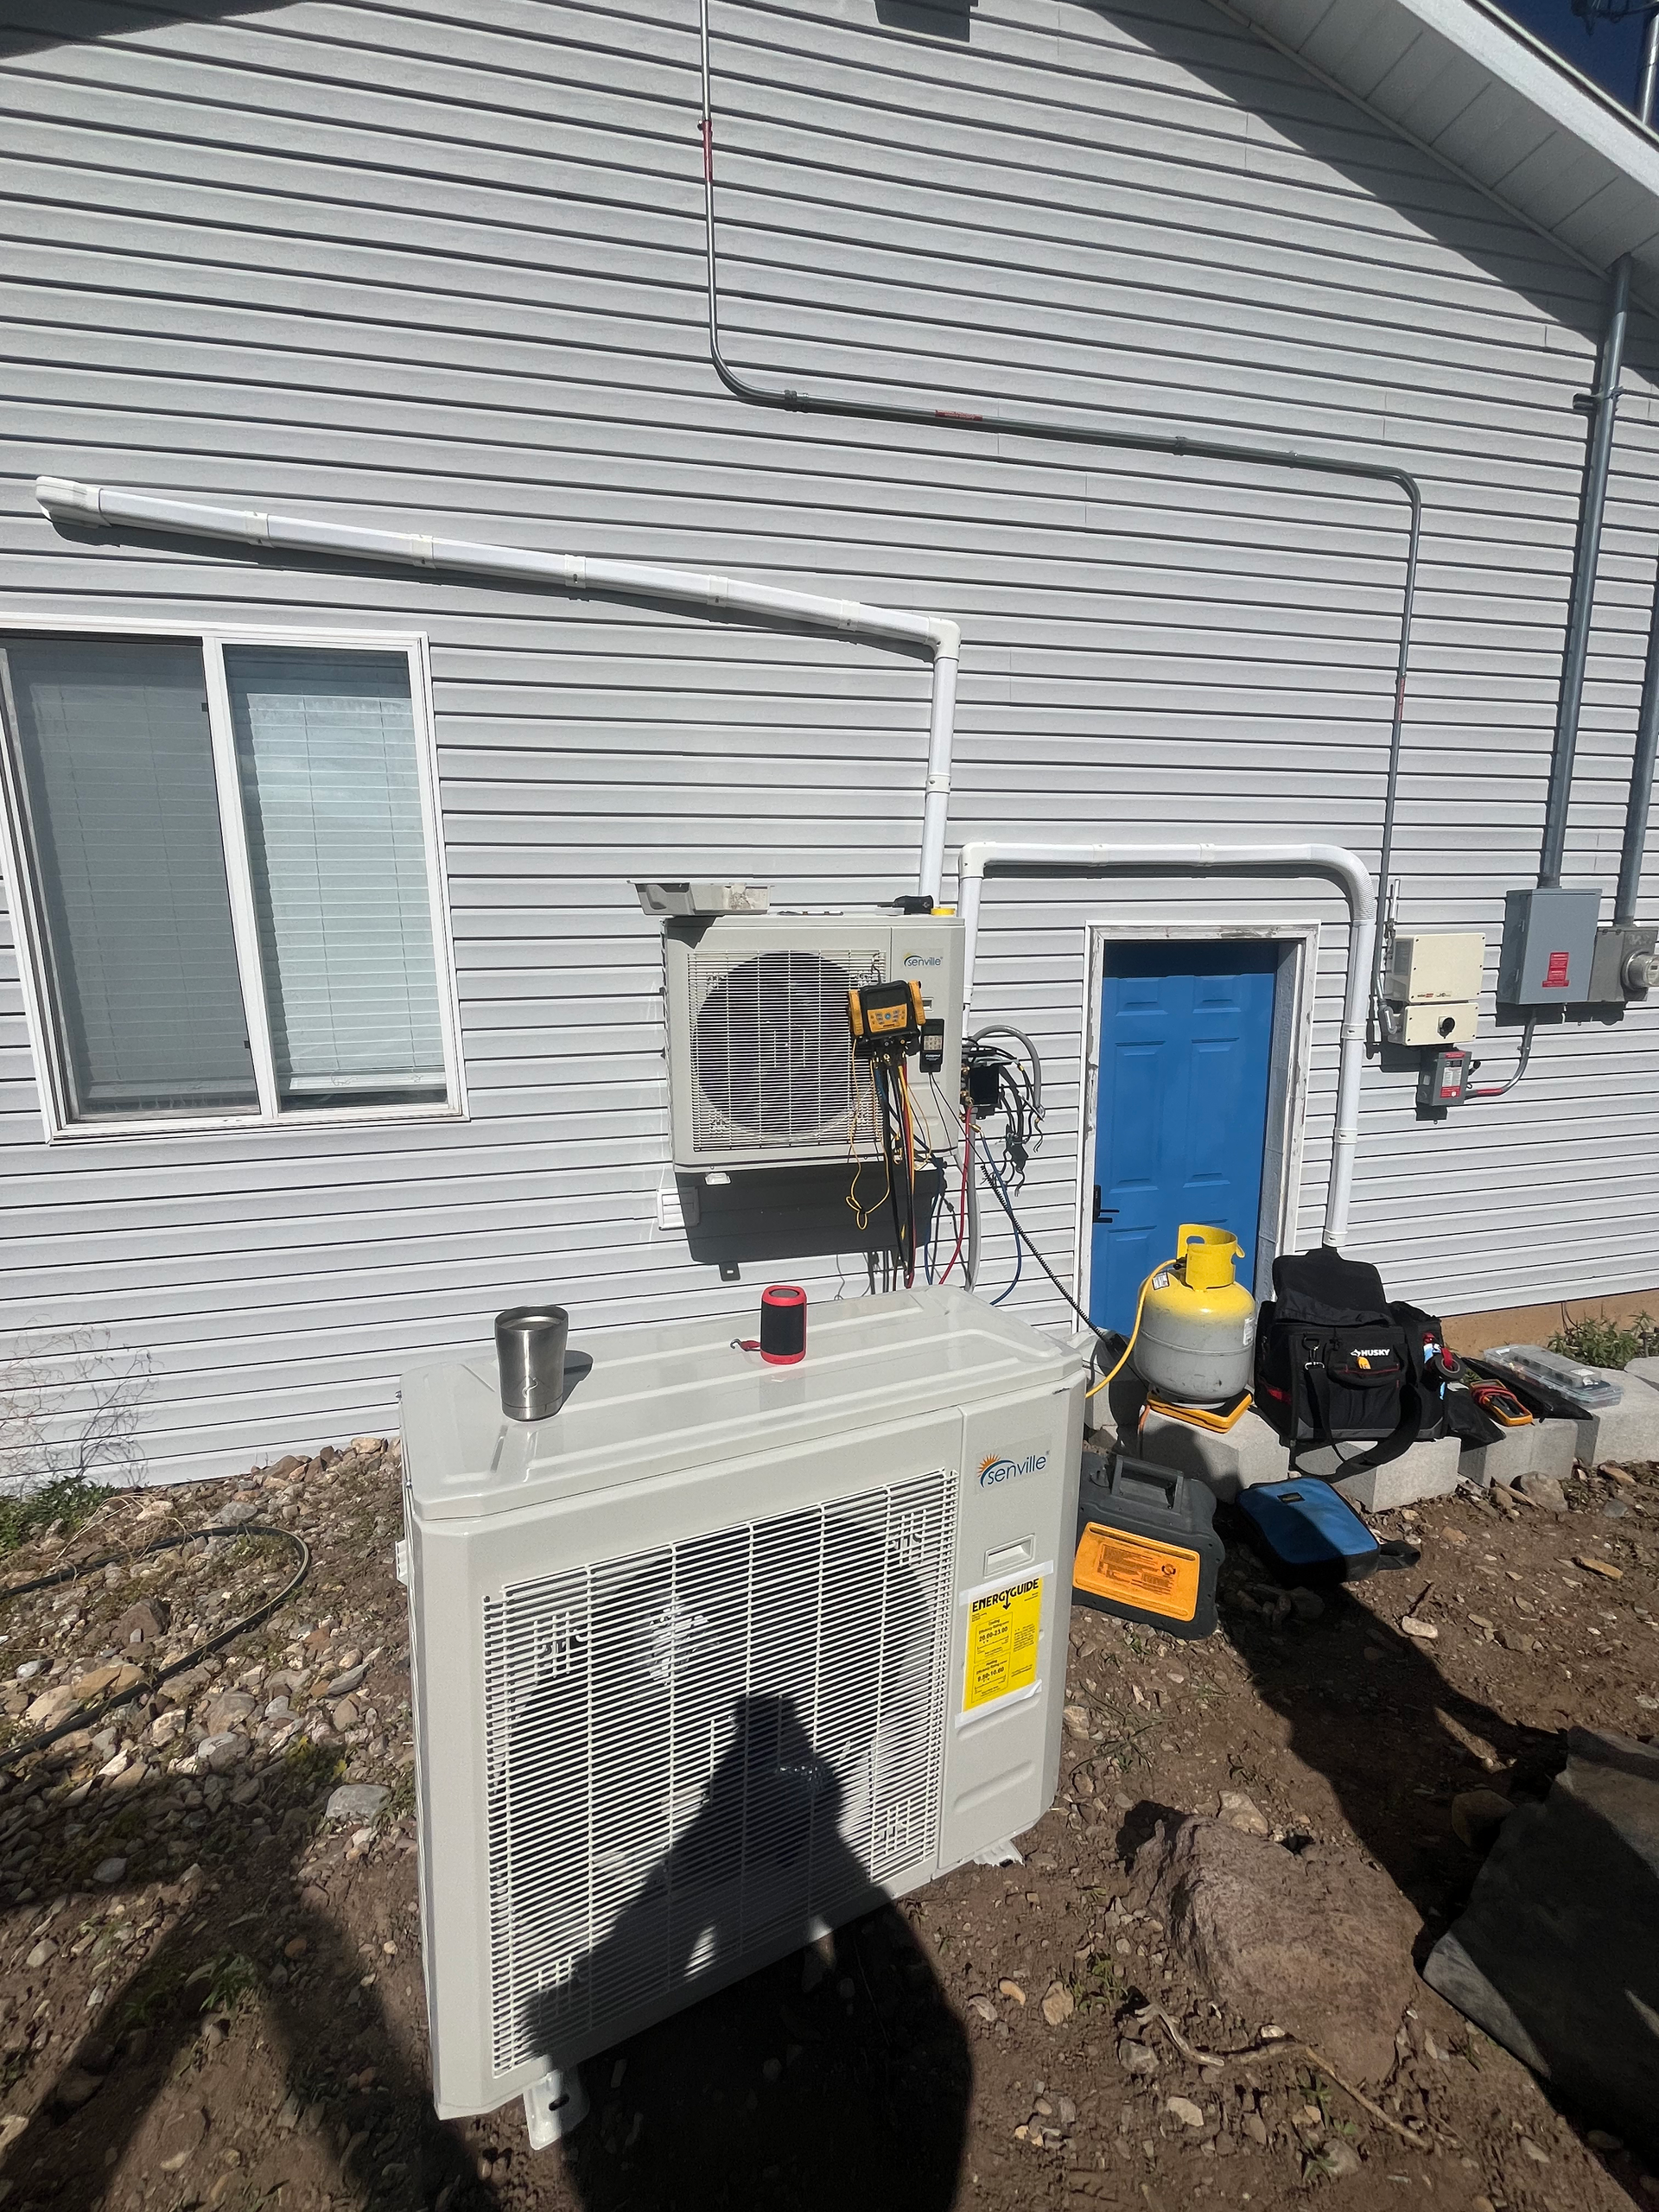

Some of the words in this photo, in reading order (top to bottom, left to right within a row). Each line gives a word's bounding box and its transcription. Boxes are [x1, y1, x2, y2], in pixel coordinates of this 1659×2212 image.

[908, 957, 942, 967] senville
[988, 1455, 1046, 1485] senville
[972, 1578, 1039, 1612] ENERGYGUIDE
